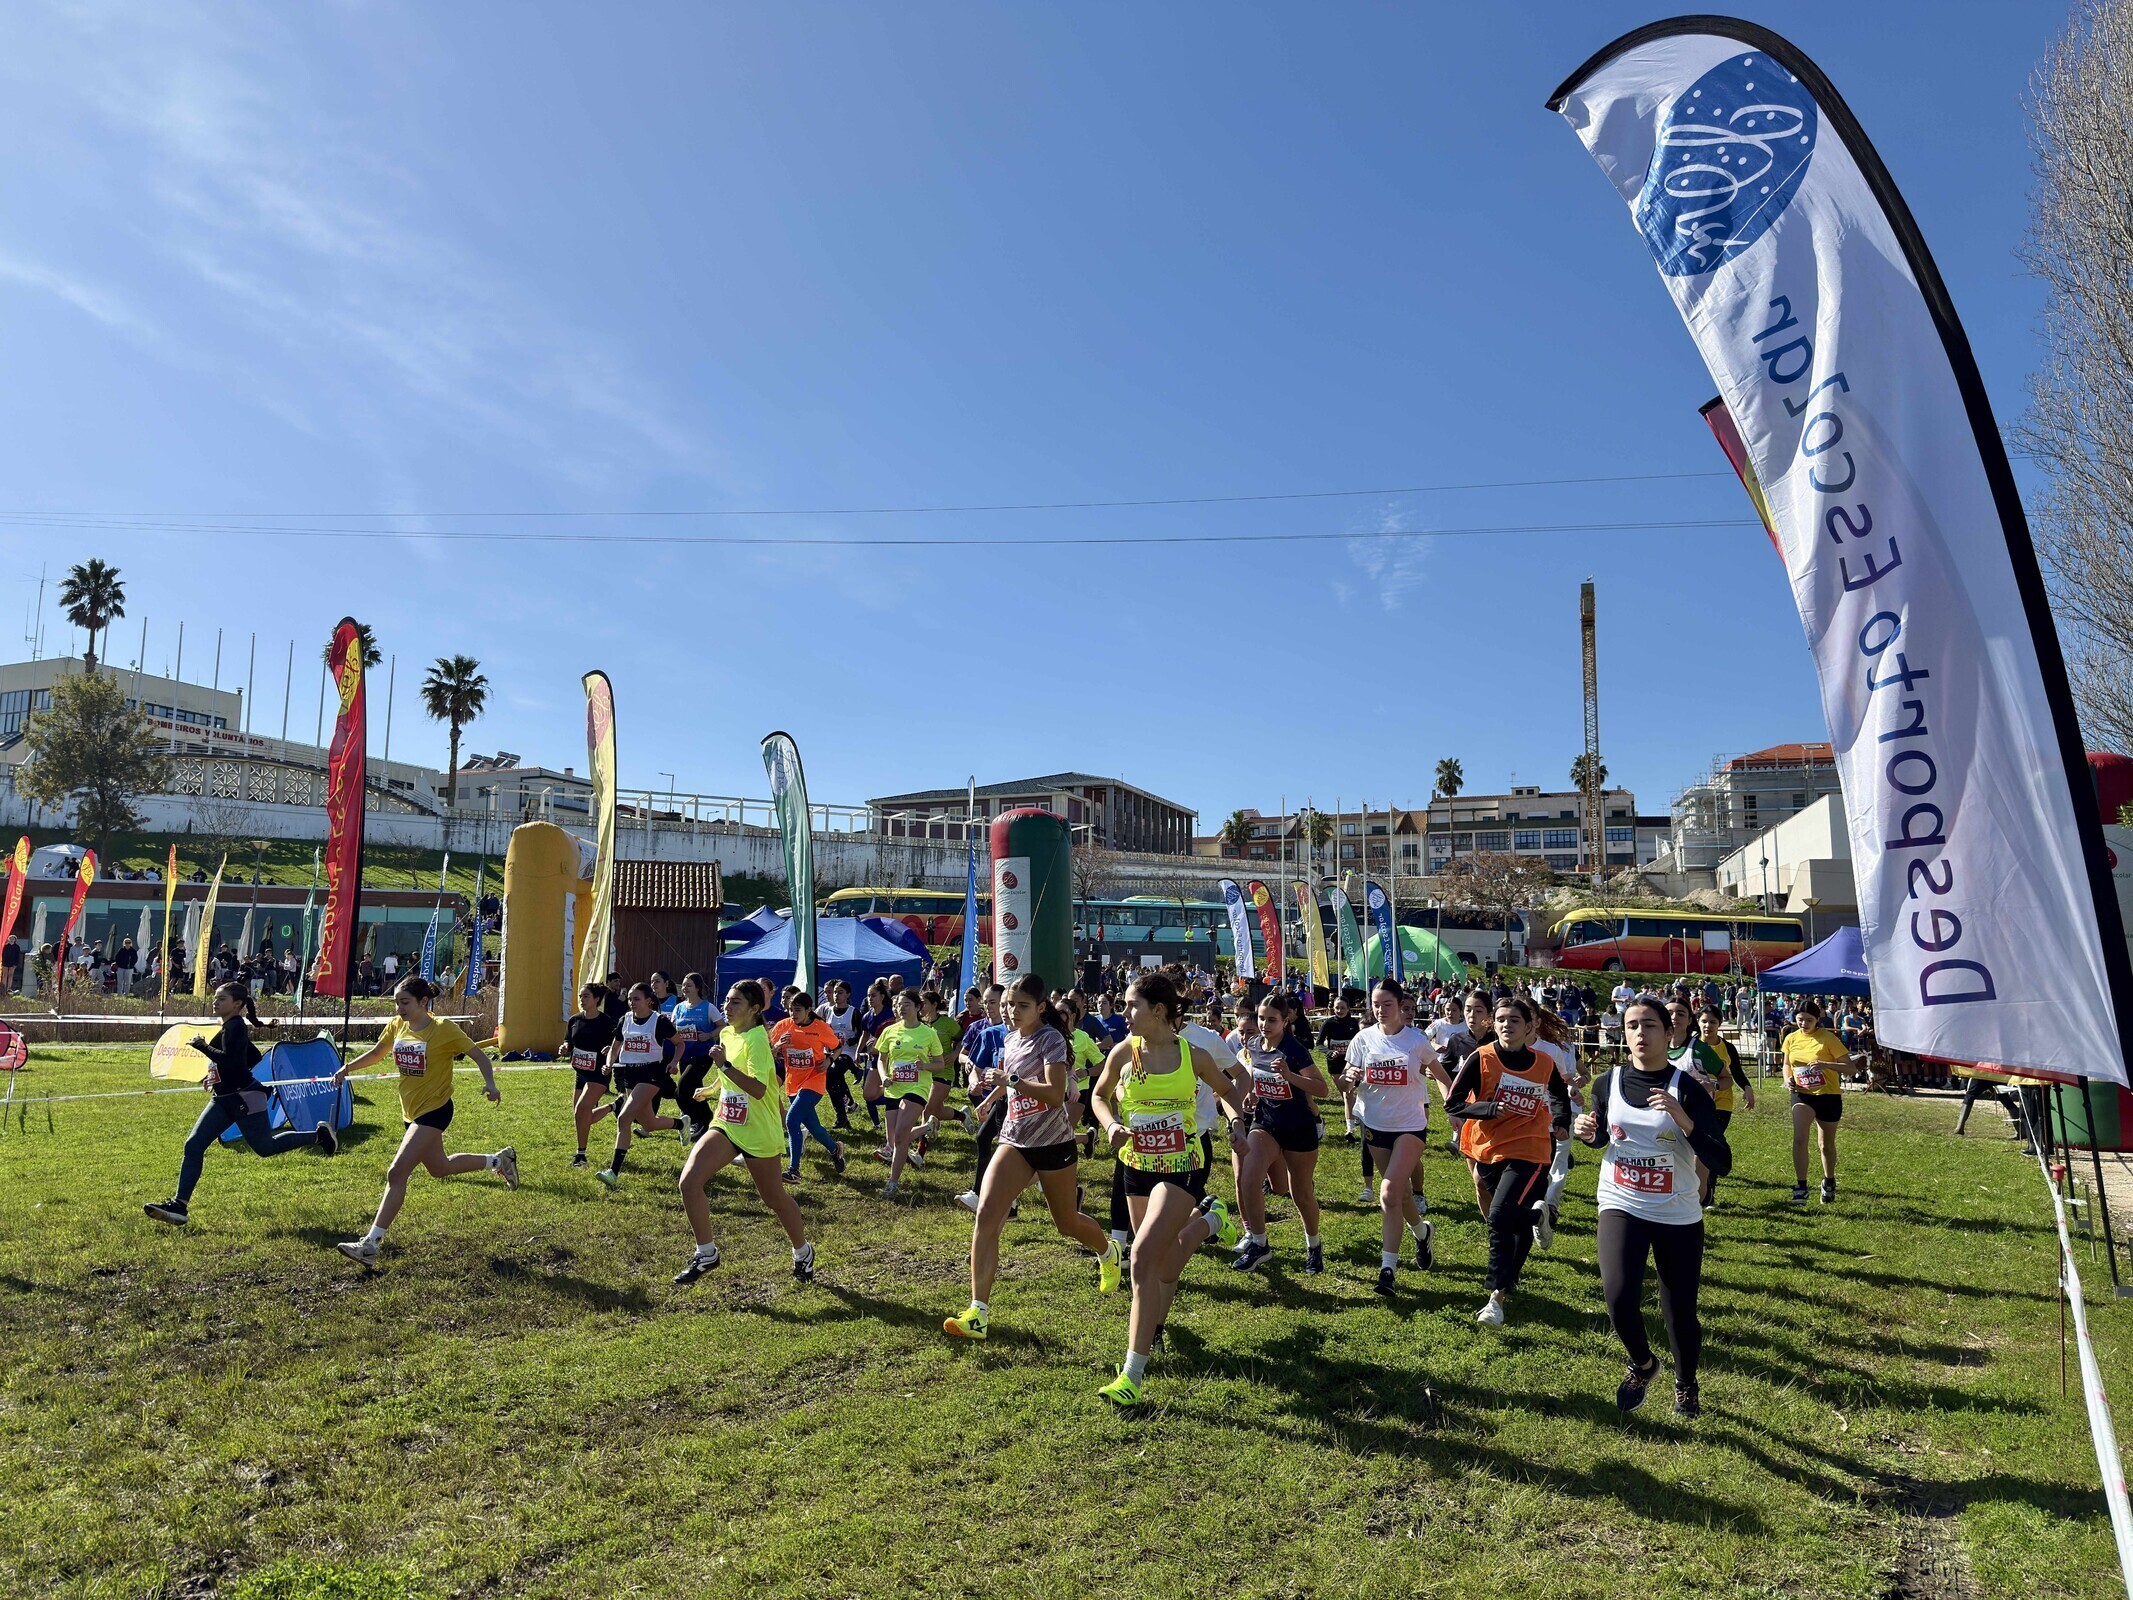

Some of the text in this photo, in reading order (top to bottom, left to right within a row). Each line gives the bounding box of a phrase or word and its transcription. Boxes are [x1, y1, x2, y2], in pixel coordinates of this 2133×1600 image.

[205, 729, 264, 747] VOLUNTÁIOS
[157, 1044, 190, 1059] Desporto
[397, 1054, 420, 1065] 3984
[575, 1057, 592, 1067] 3983
[895, 1070, 916, 1080] 3936
[1370, 1069, 1402, 1081] 3919
[1799, 1075, 1821, 1085] 3904
[1259, 1082, 1286, 1095] 3982
[1501, 1091, 1536, 1110] 3906
[1137, 1132, 1176, 1147] 3921
[1620, 1165, 1665, 1187] 3912
